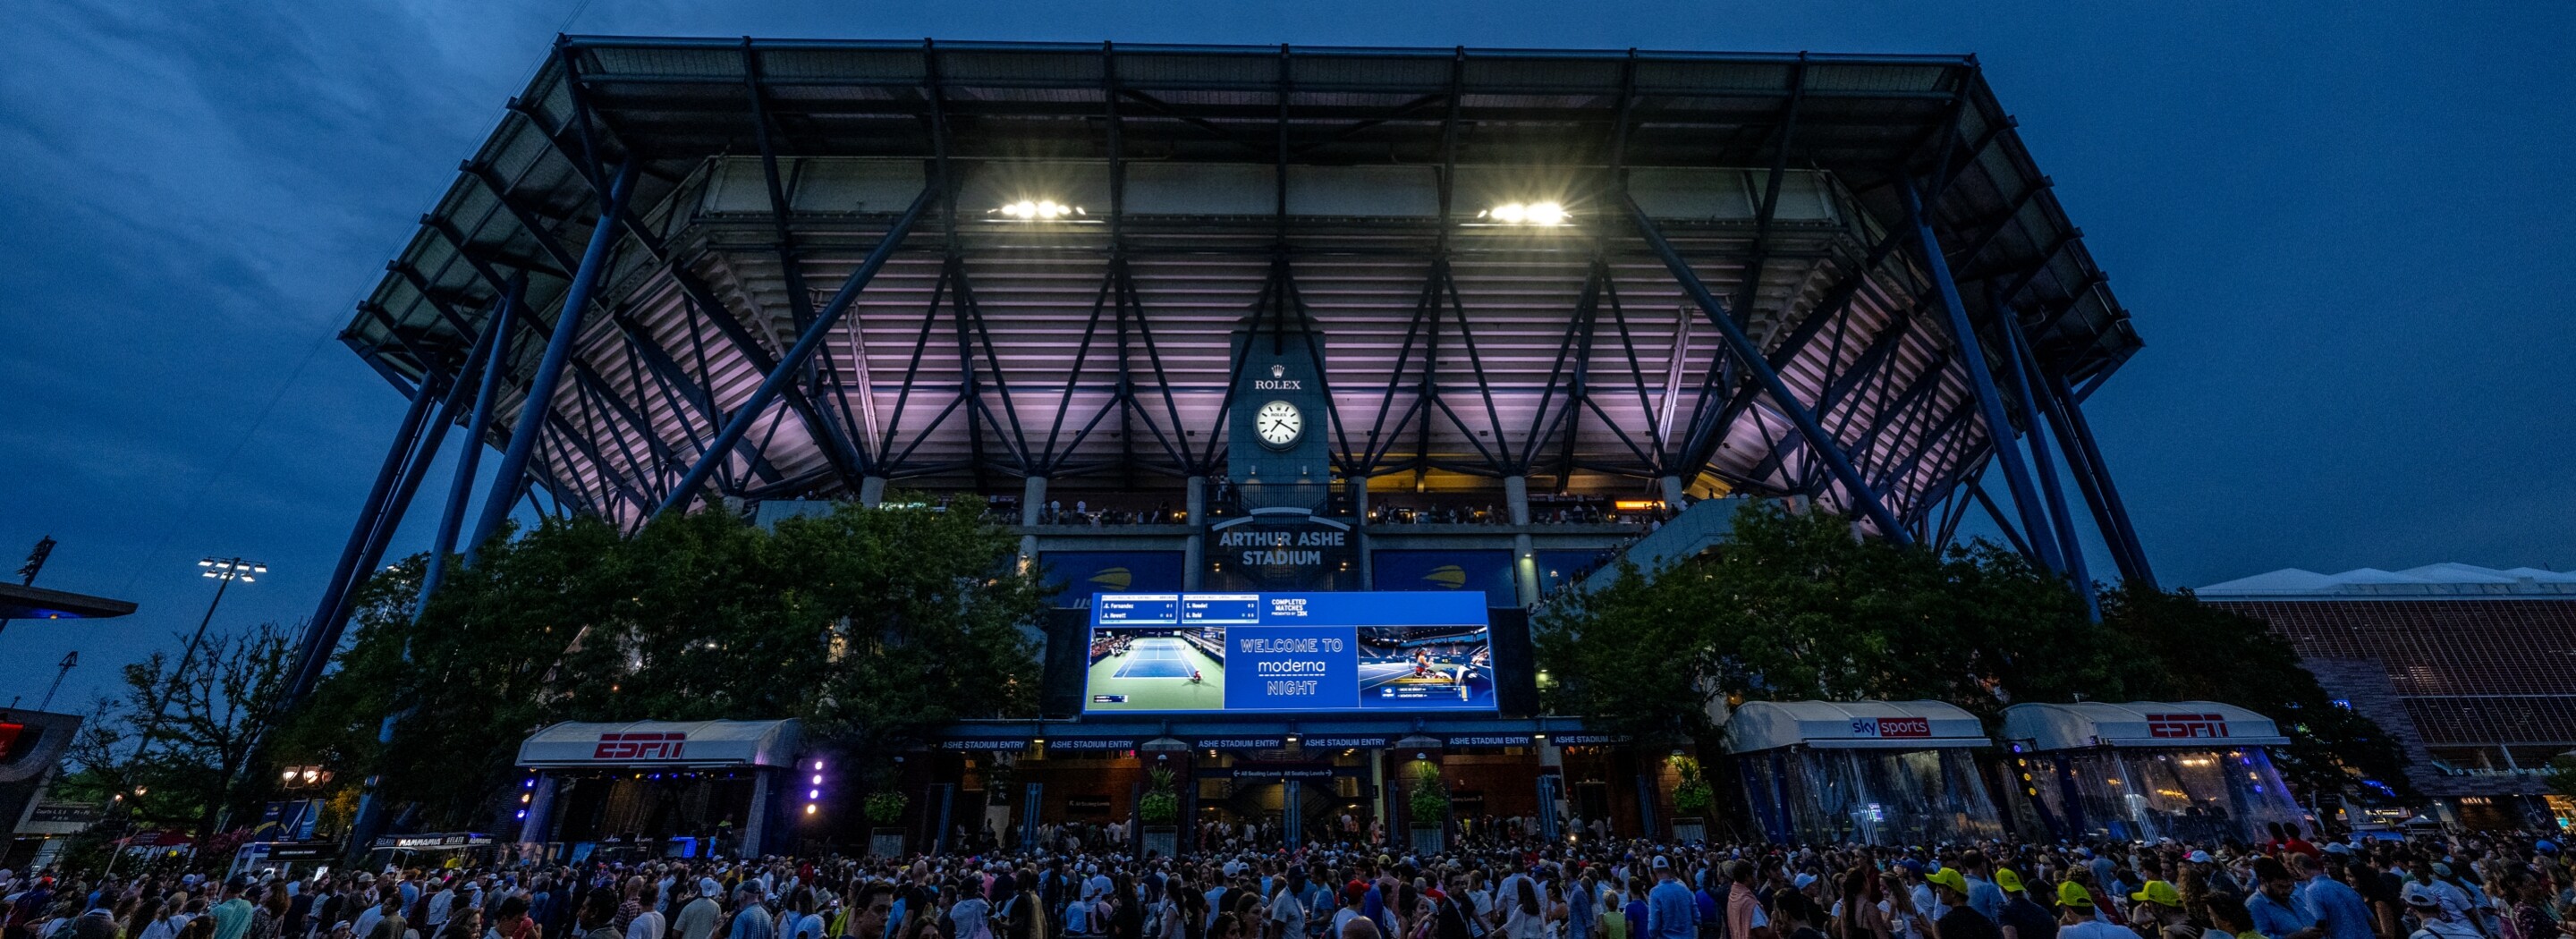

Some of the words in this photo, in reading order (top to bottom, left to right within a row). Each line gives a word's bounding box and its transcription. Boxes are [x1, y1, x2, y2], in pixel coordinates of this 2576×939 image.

[1254, 380, 1301, 390] ROLEX
[1218, 531, 1292, 546] ARTHUR
[1297, 531, 1345, 546] ASHE
[1242, 550, 1321, 565] STADIUM
[1241, 639, 1318, 653] WELCOME
[1322, 638, 1343, 653] TO
[1258, 658, 1326, 673] moderna
[1267, 681, 1318, 696] NIGHT
[1852, 718, 1876, 736] sky
[1881, 720, 1928, 735] sports
[2146, 714, 2229, 738] ESPN
[1198, 740, 1219, 748] ASHE
[1220, 740, 1254, 748] STADIUM
[1255, 740, 1280, 748] ENTRY
[1304, 738, 1326, 747] ASHE
[1326, 738, 1360, 747] STADIUM
[1360, 738, 1385, 747] ENTRY
[1449, 737, 1470, 745] ASHE
[1470, 737, 1504, 745] STADIUM
[1504, 737, 1530, 745] ENTRY
[1555, 735, 1576, 743] ASHE
[1576, 735, 1609, 743] STADIUM
[593, 732, 686, 758] ESPN
[942, 740, 963, 749] ASHE
[964, 740, 999, 749] STADIUM
[999, 740, 1025, 749] ENTRY
[1051, 740, 1072, 749] ASHE
[1073, 740, 1106, 749] STADIUM
[1107, 740, 1133, 749] ENTRY
[376, 837, 395, 845] GELATO
[399, 838, 443, 847] MAMMAMIA
